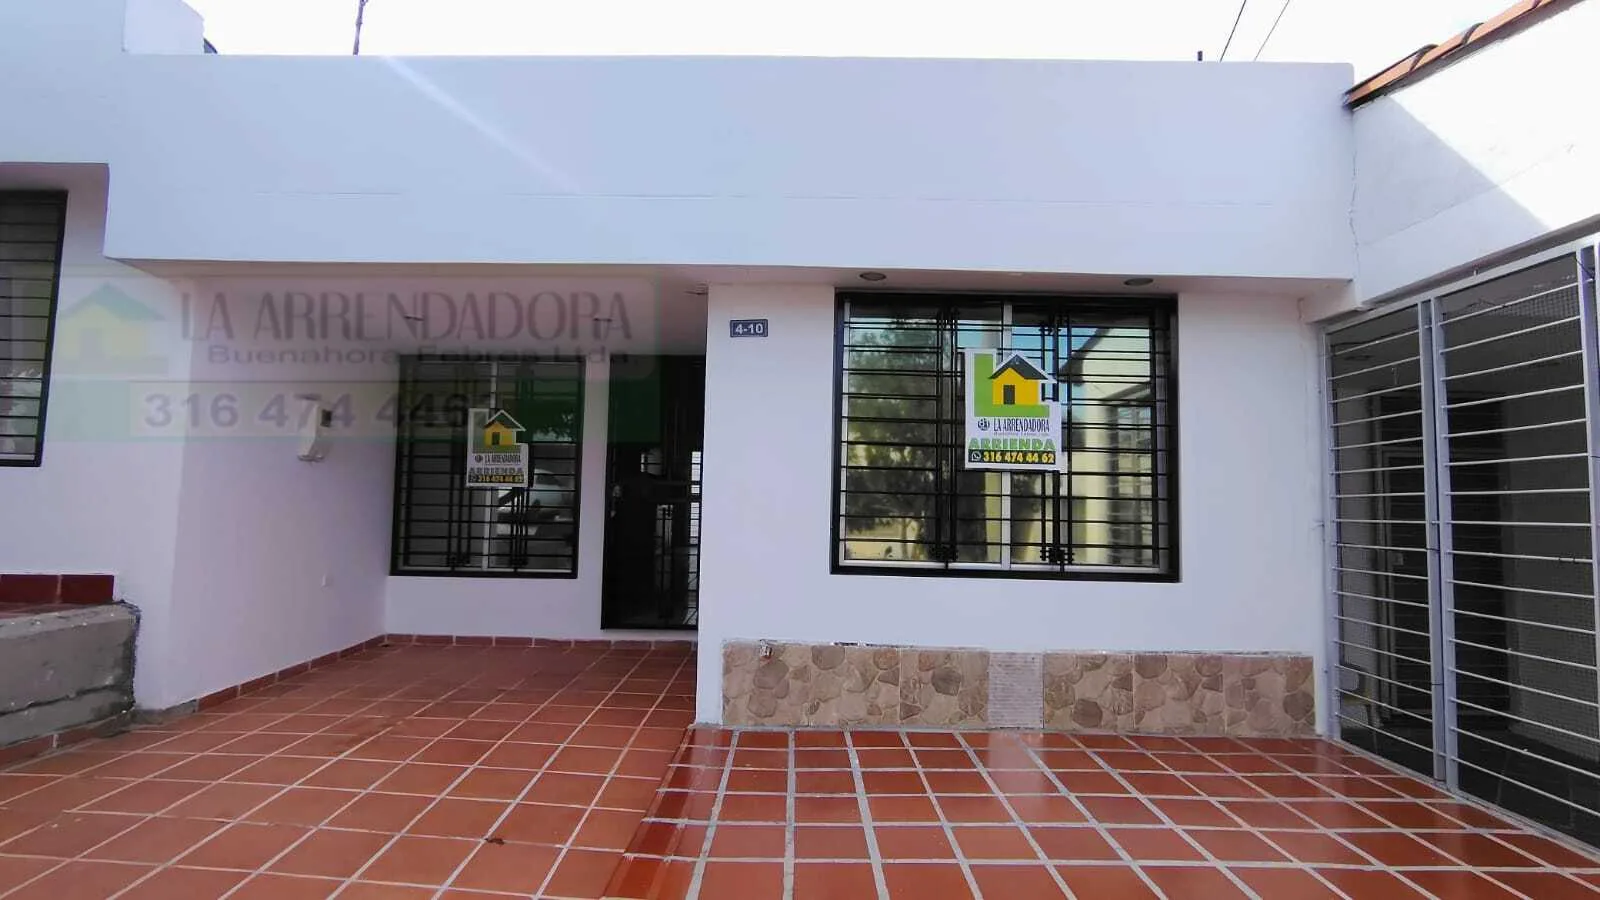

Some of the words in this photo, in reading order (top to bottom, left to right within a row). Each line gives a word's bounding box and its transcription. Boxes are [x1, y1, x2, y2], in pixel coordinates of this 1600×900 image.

[735, 323, 764, 335] 4-10
[993, 417, 1002, 432] LA
[1003, 417, 1050, 433] ARRENDADORA
[968, 437, 1056, 451] ARRIENDA
[983, 451, 1002, 462] 316
[1004, 451, 1024, 463] 474
[1026, 452, 1039, 463] 44
[1041, 453, 1055, 464] 62
